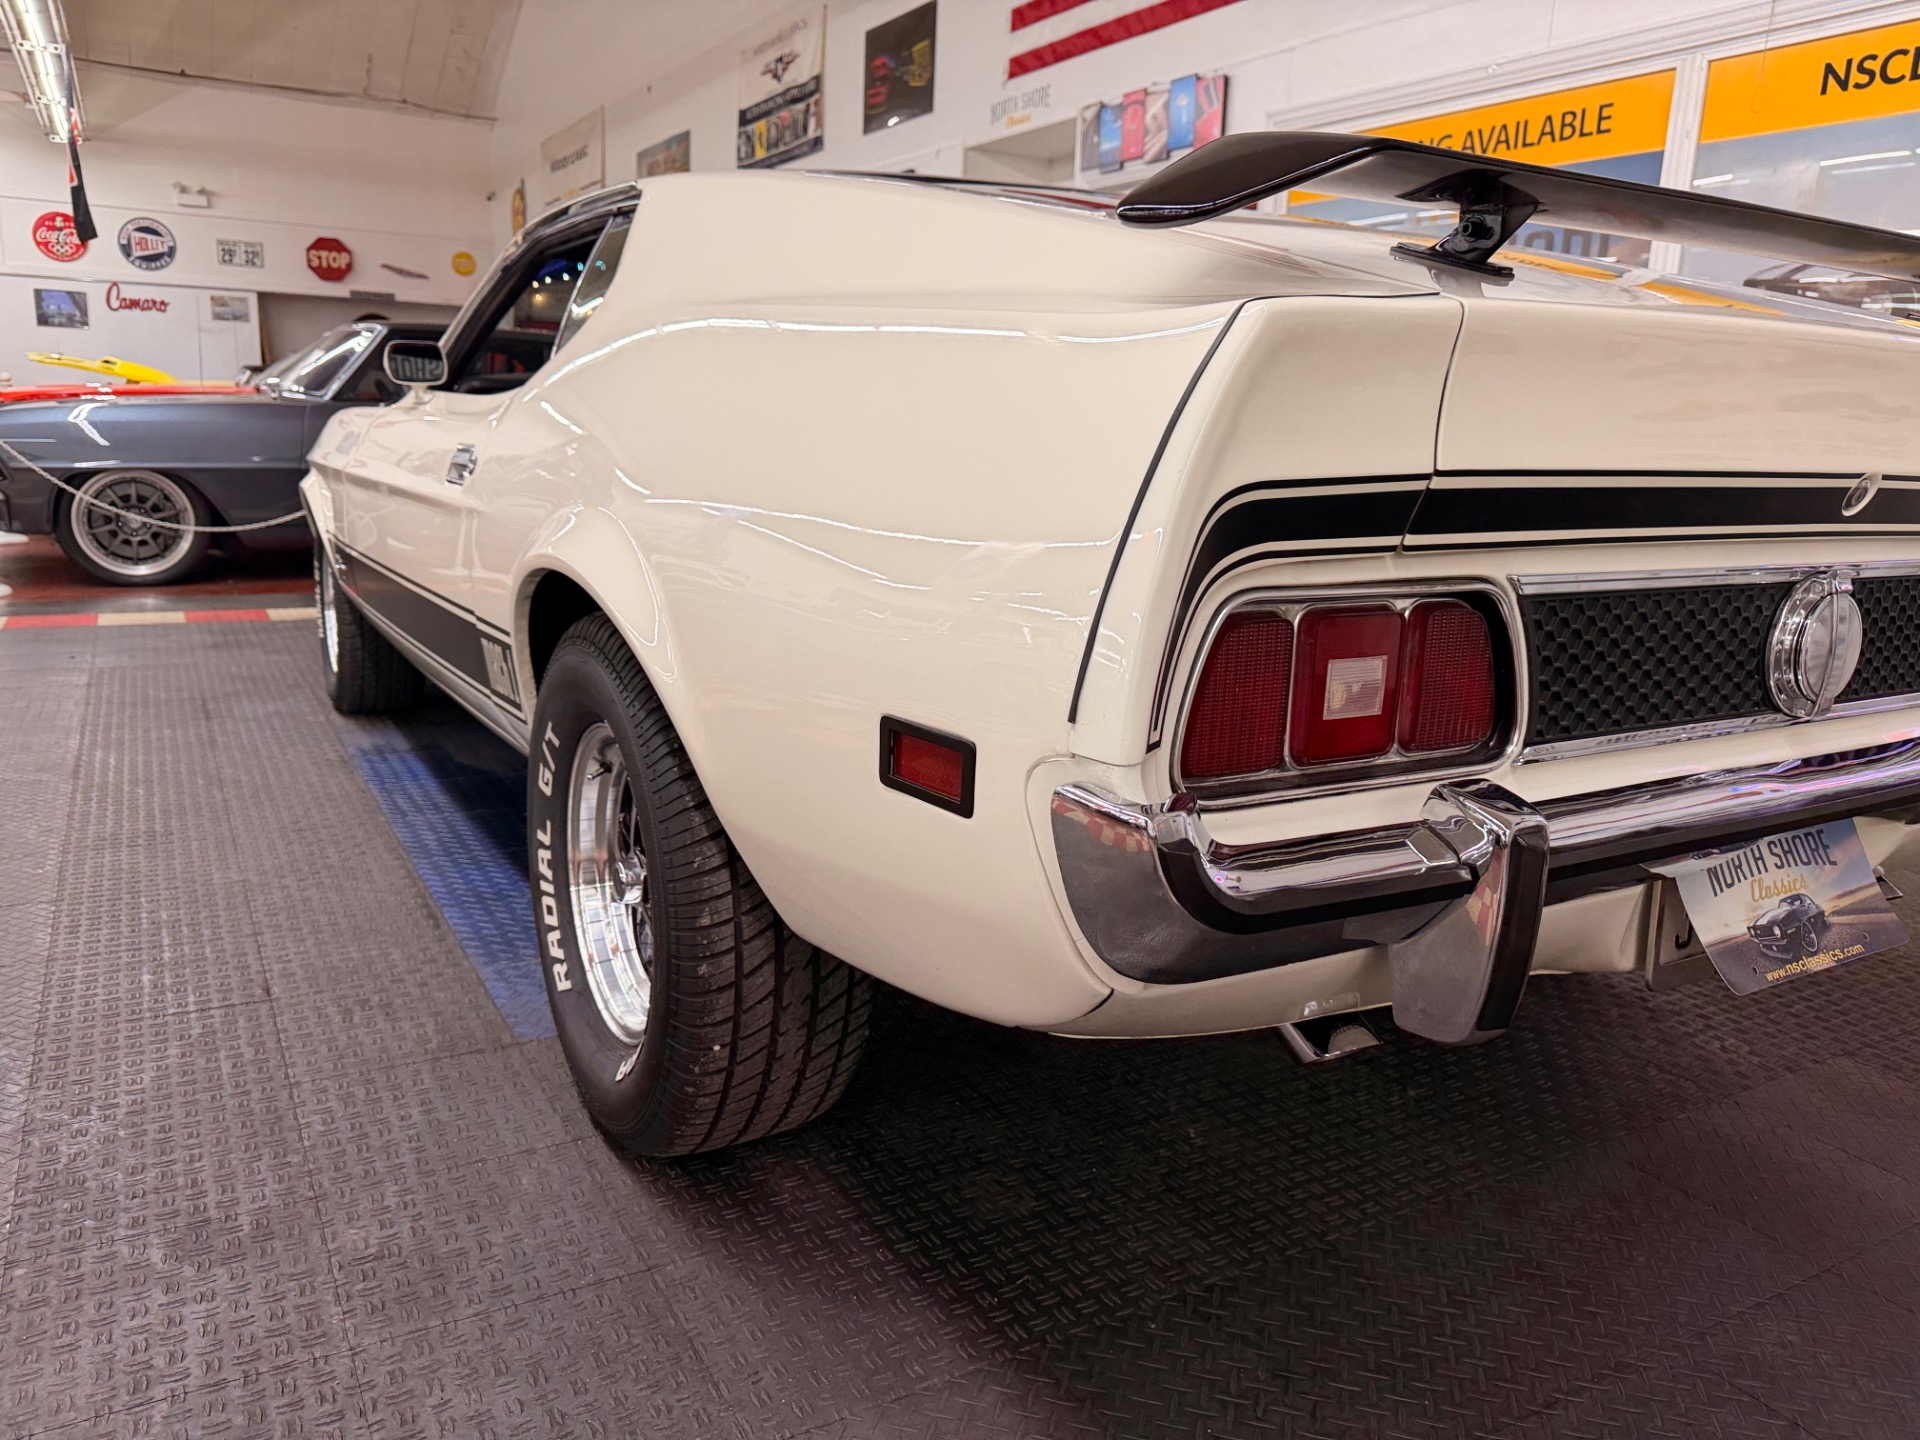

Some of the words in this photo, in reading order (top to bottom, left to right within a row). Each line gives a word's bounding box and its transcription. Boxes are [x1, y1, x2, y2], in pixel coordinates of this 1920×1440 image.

[1461, 102, 1614, 154] AVAILABLE
[308, 249, 350, 270] STOP
[106, 281, 170, 313] Camaro
[1706, 844, 1769, 897] NORTH
[1768, 828, 1838, 870] SHORE
[536, 819, 572, 992] RADIAL
[1751, 873, 1810, 902] Classics
[1764, 943, 1865, 982] www.nsclassics.com
